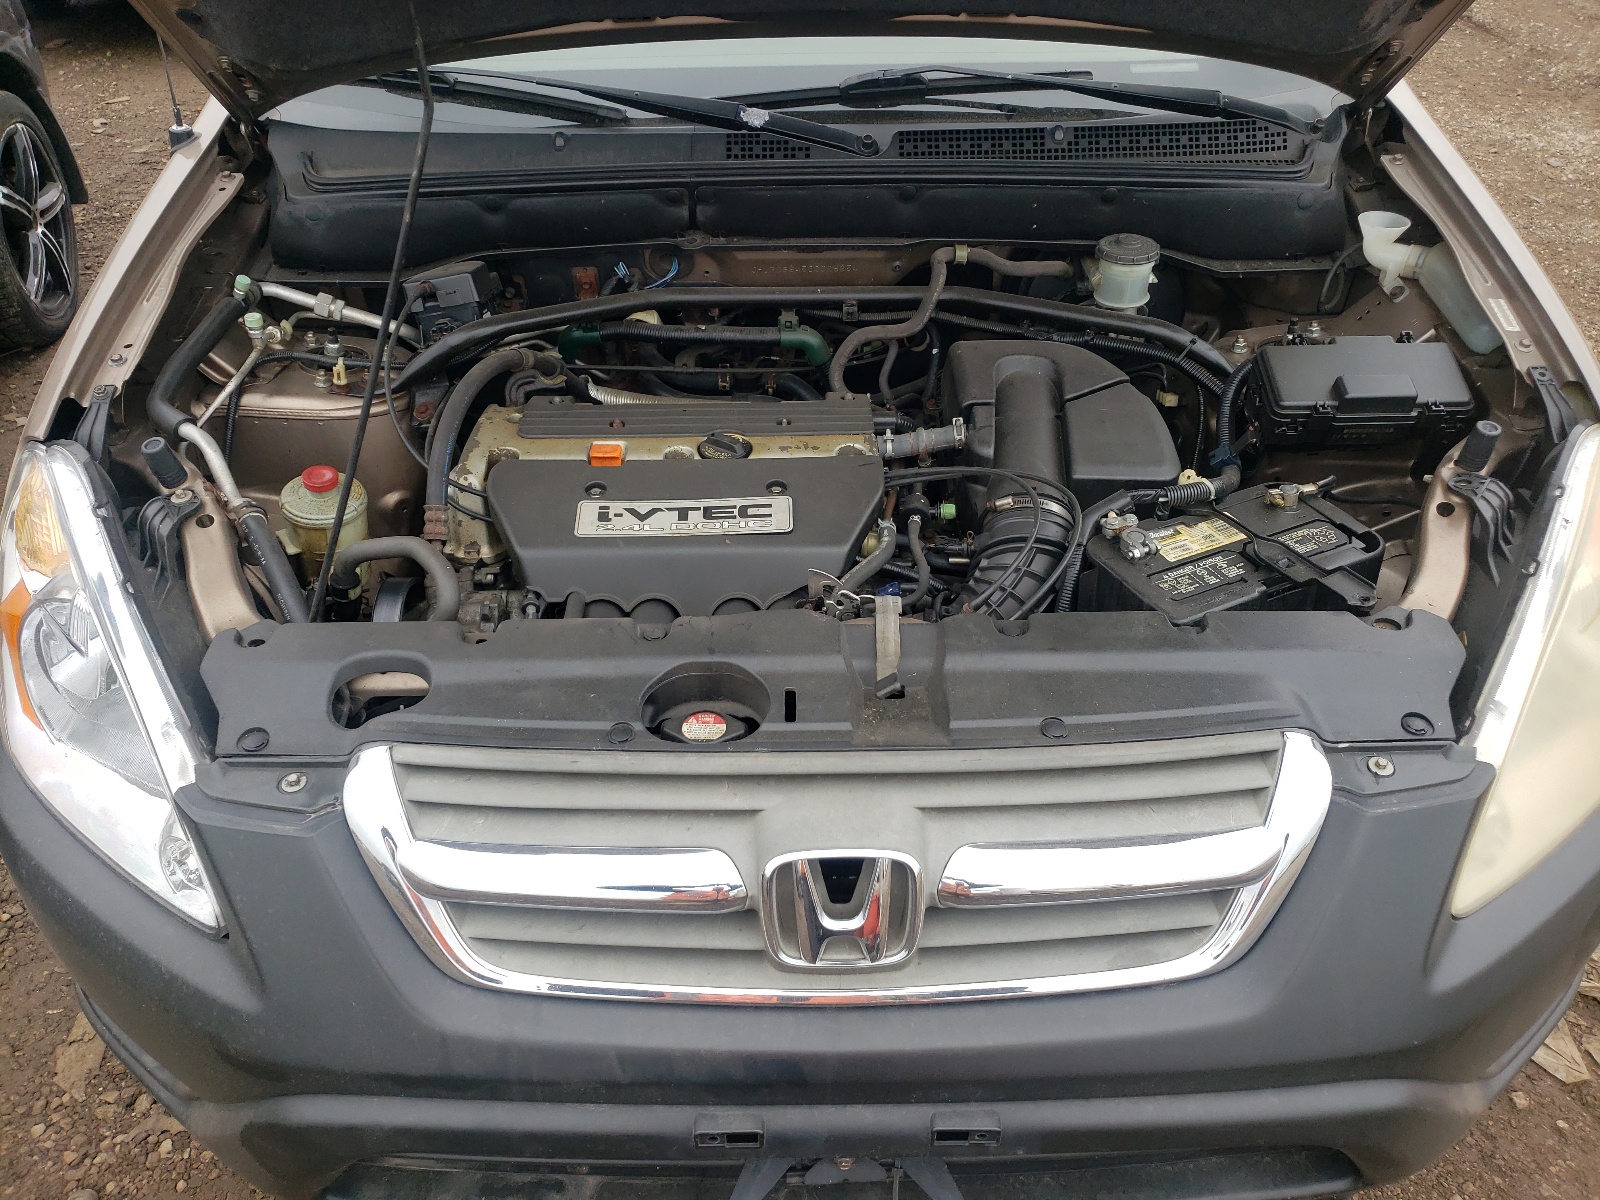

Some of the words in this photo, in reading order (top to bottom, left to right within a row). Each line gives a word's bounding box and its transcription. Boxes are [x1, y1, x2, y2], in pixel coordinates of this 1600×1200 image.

[597, 503, 773, 522] i-VTEC
[596, 523, 665, 532] 2.4L
[670, 519, 773, 531] DOHC
